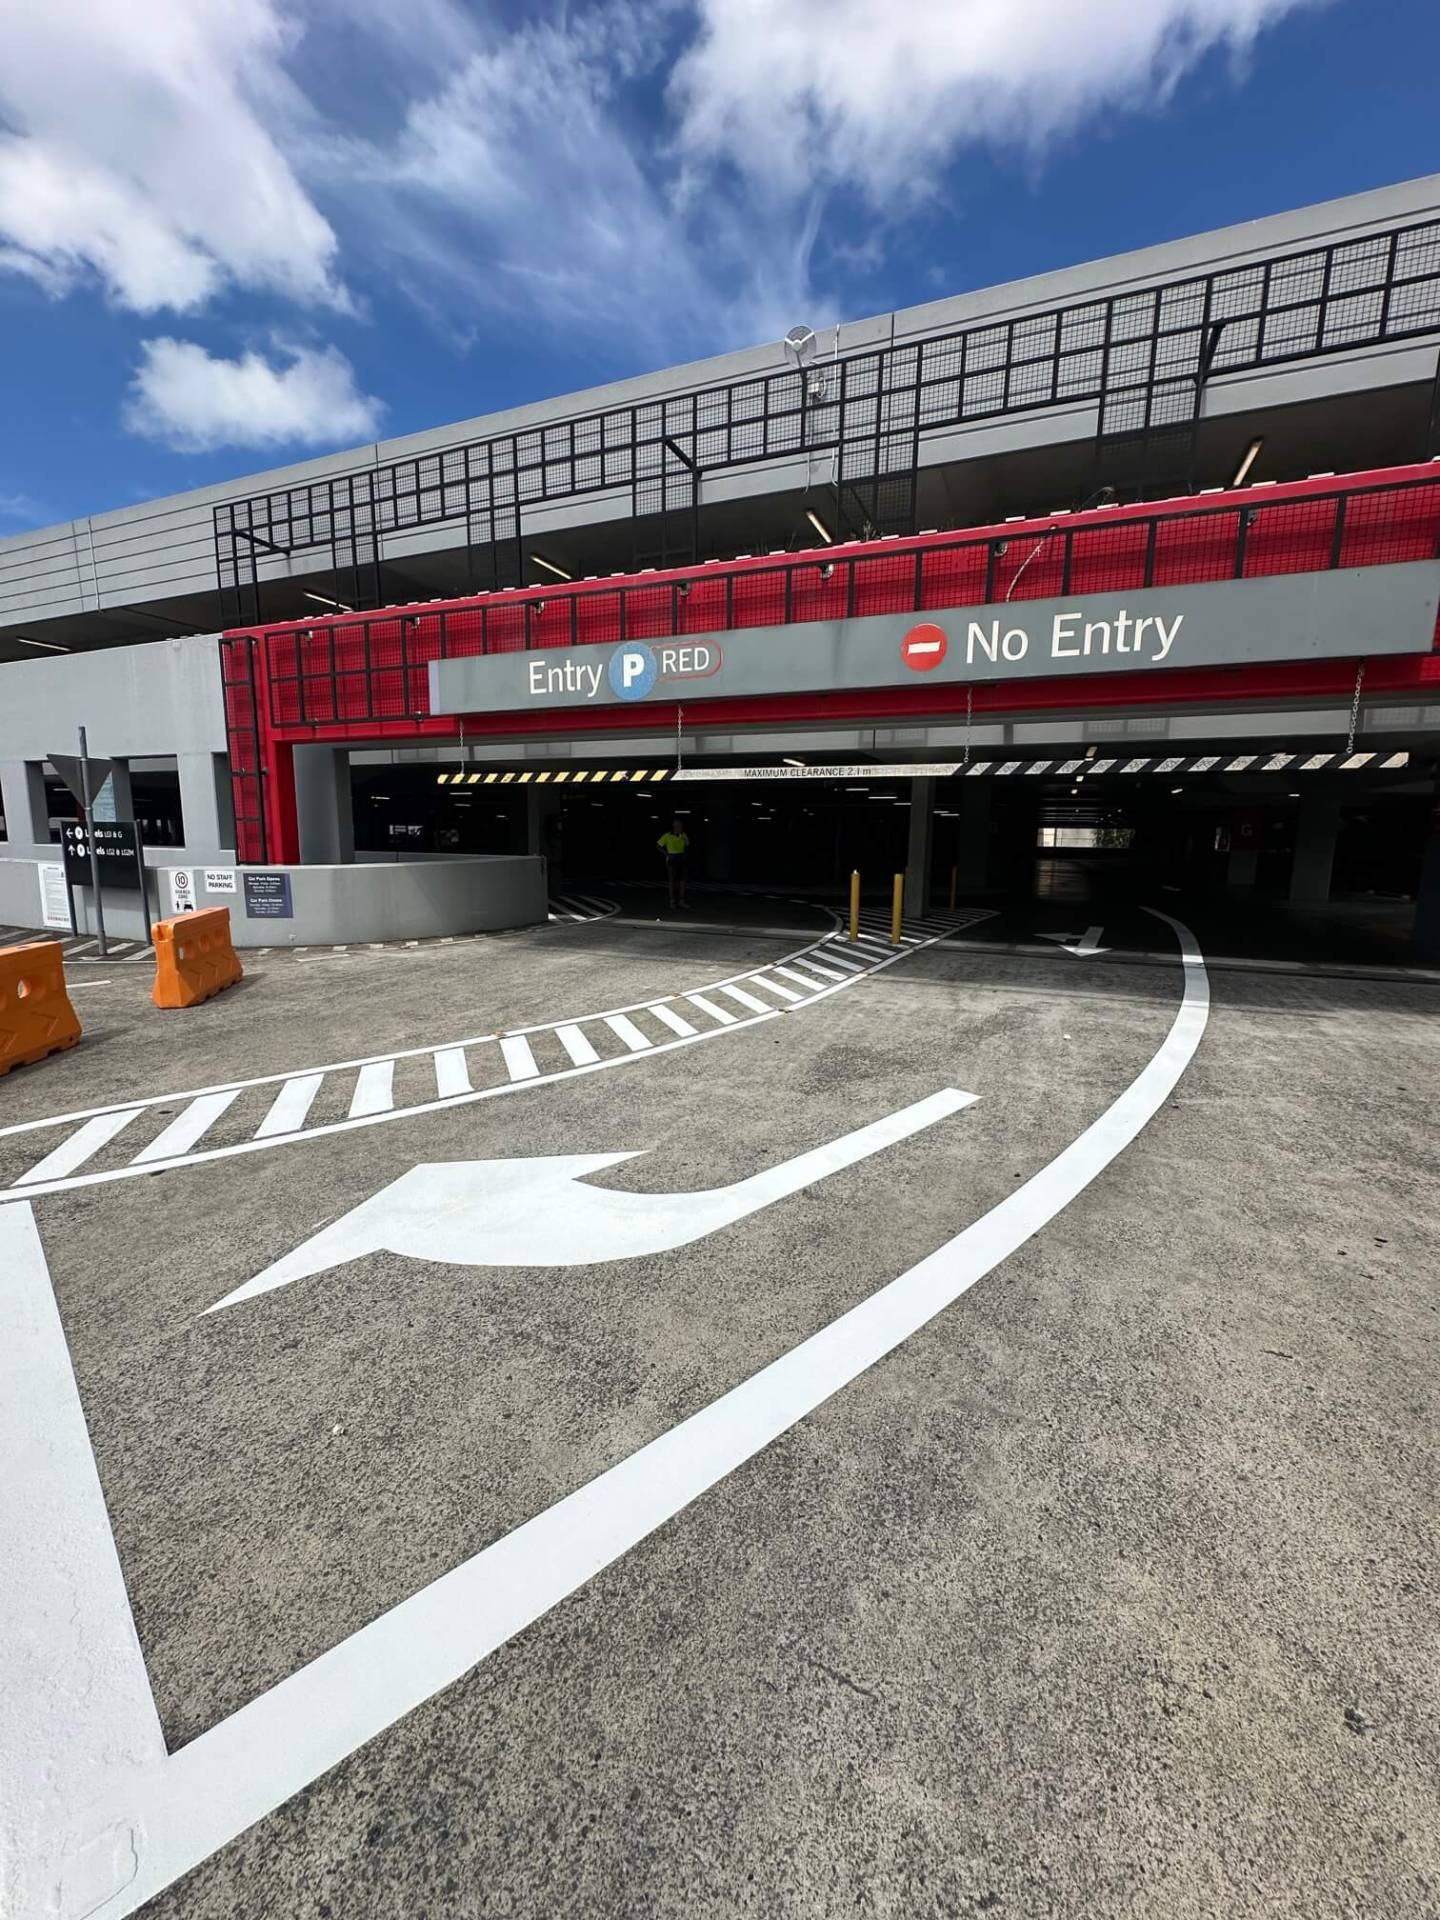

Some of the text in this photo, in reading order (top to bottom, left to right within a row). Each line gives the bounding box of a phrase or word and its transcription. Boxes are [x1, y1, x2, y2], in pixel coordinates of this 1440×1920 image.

[966, 610, 1184, 664] No Entry
[529, 647, 709, 697] Entry P RED
[744, 768, 788, 777] MAXIMUM
[790, 767, 844, 777] CLEARANCE
[84, 828, 104, 838] Lels
[86, 845, 106, 855] Lels
[178, 875, 186, 885] 10
[208, 881, 233, 889] PARKING
